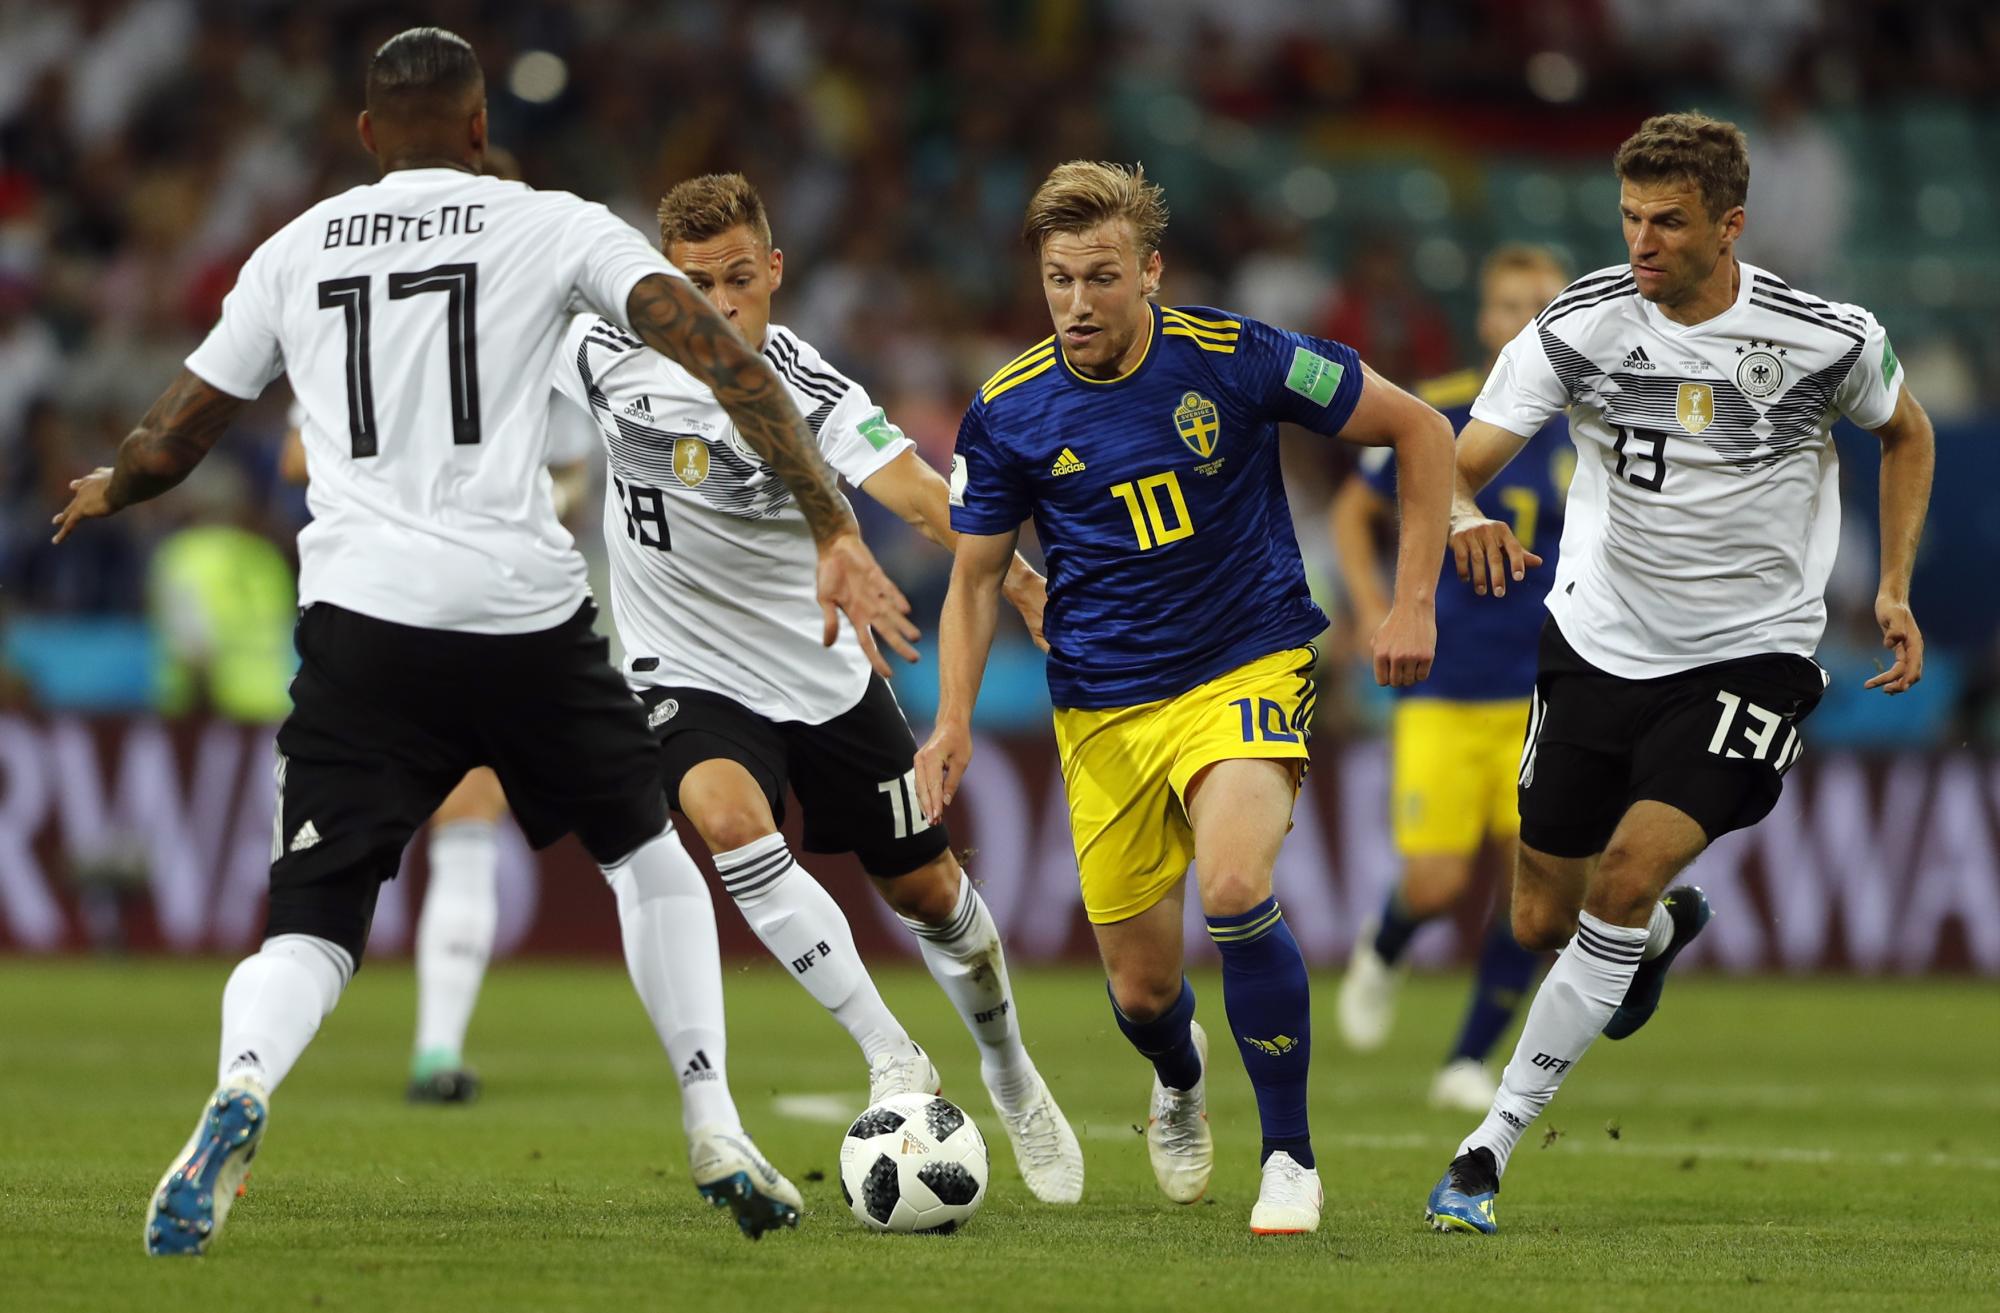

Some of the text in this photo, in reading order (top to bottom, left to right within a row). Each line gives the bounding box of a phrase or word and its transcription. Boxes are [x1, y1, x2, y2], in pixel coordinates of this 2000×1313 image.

[324, 205, 485, 250] BOATENG
[318, 262, 481, 459] 17
[1622, 359, 1656, 371] addas
[624, 406, 655, 423] adidas
[1051, 462, 1086, 477] adidas
[1608, 422, 1668, 493] 13
[1110, 470, 1194, 551] 10
[1229, 697, 1300, 743] 10
[1707, 689, 1783, 760] 13
[792, 941, 831, 974] DFB
[903, 1129, 930, 1154] adidas
